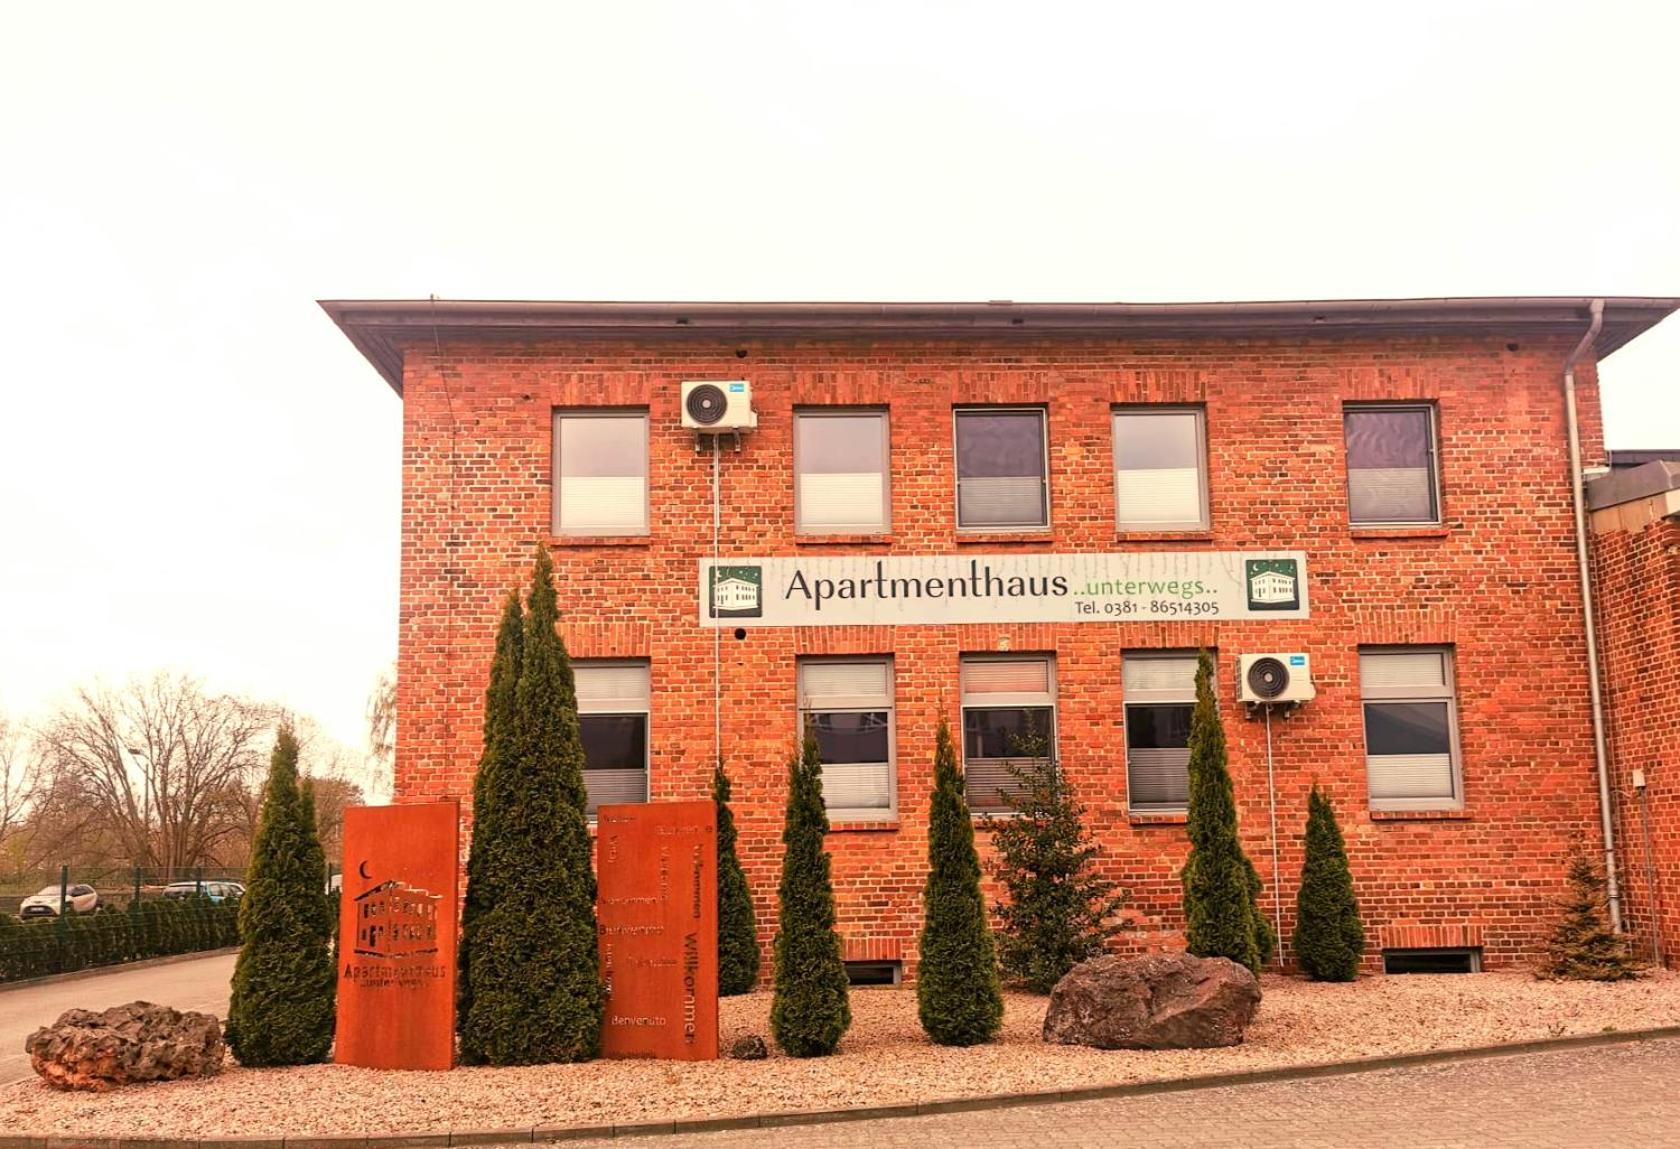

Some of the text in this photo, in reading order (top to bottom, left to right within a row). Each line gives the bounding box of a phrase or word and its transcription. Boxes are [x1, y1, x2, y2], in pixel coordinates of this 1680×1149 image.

[785, 559, 1068, 611] Apartmenthaus
[1075, 601, 1100, 614] Tel.
[1104, 600, 1138, 616] 0381
[1150, 600, 1219, 615] 86514305
